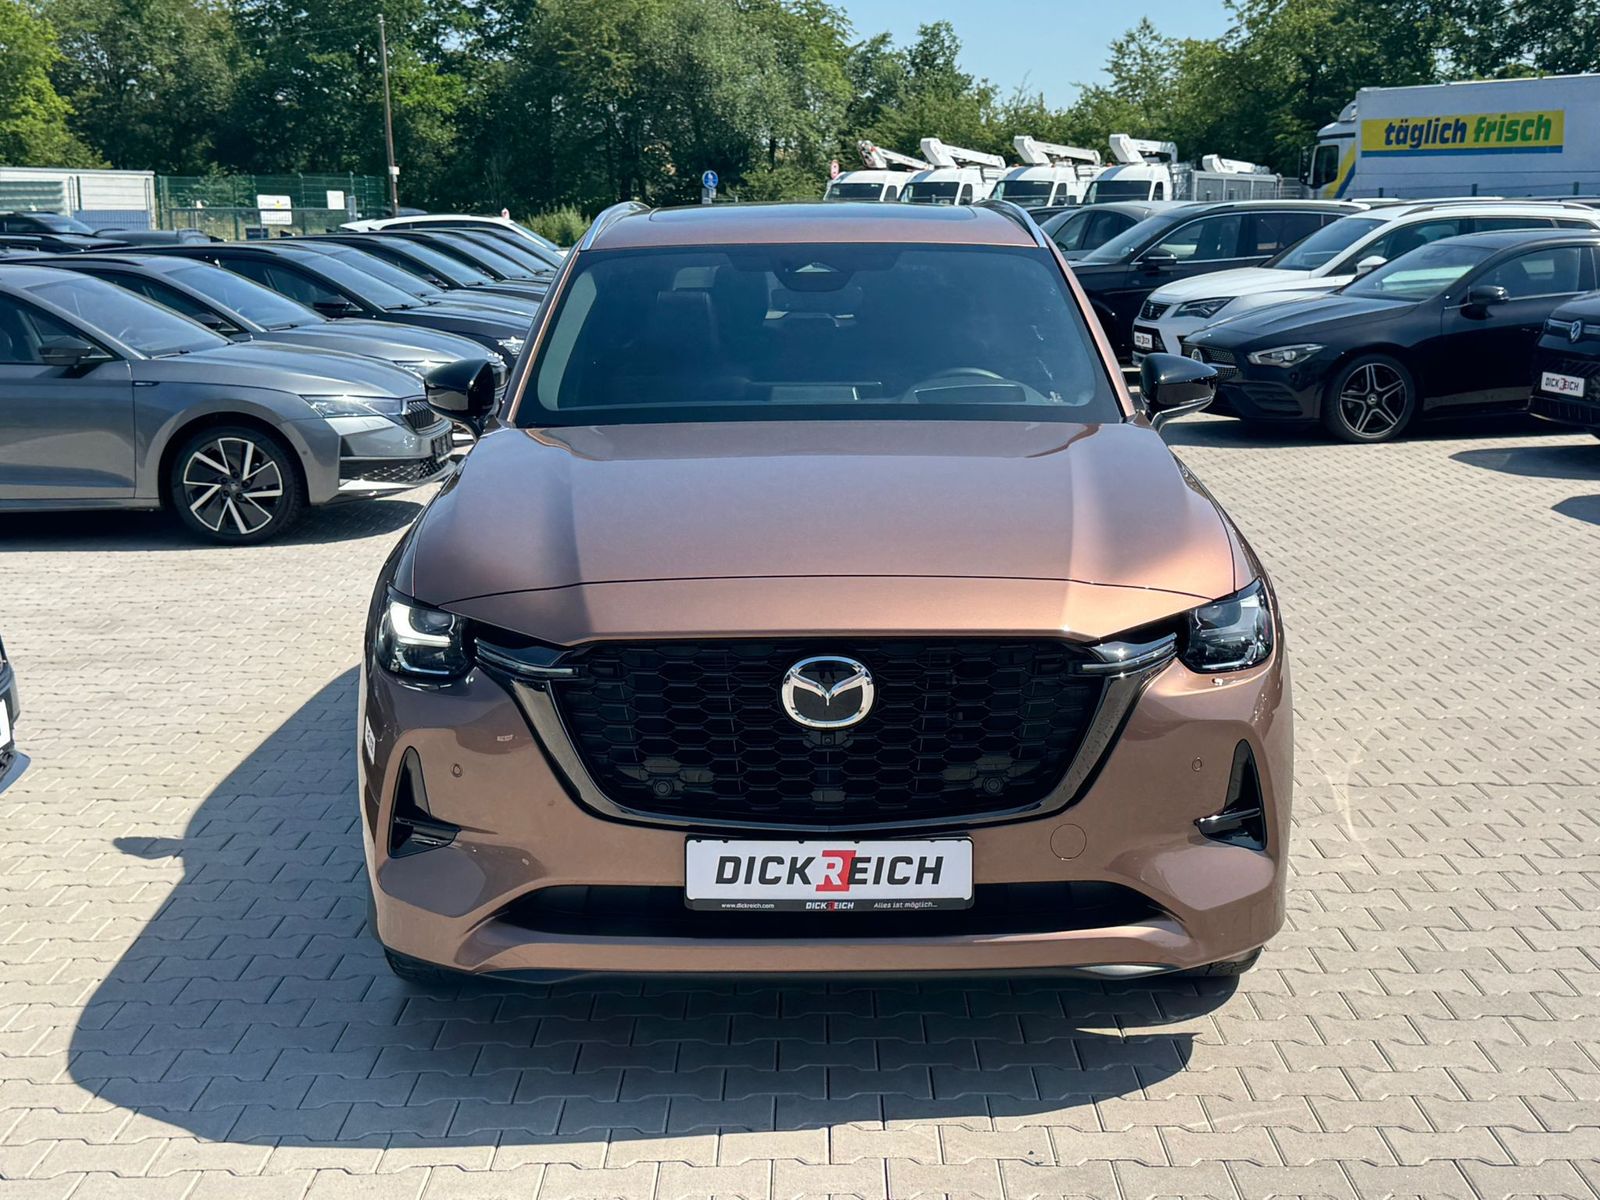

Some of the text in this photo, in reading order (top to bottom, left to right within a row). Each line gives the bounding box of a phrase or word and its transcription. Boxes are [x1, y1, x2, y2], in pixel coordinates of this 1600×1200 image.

[1384, 114, 1552, 148] täglich frisch
[715, 850, 944, 891] DICKREICH
